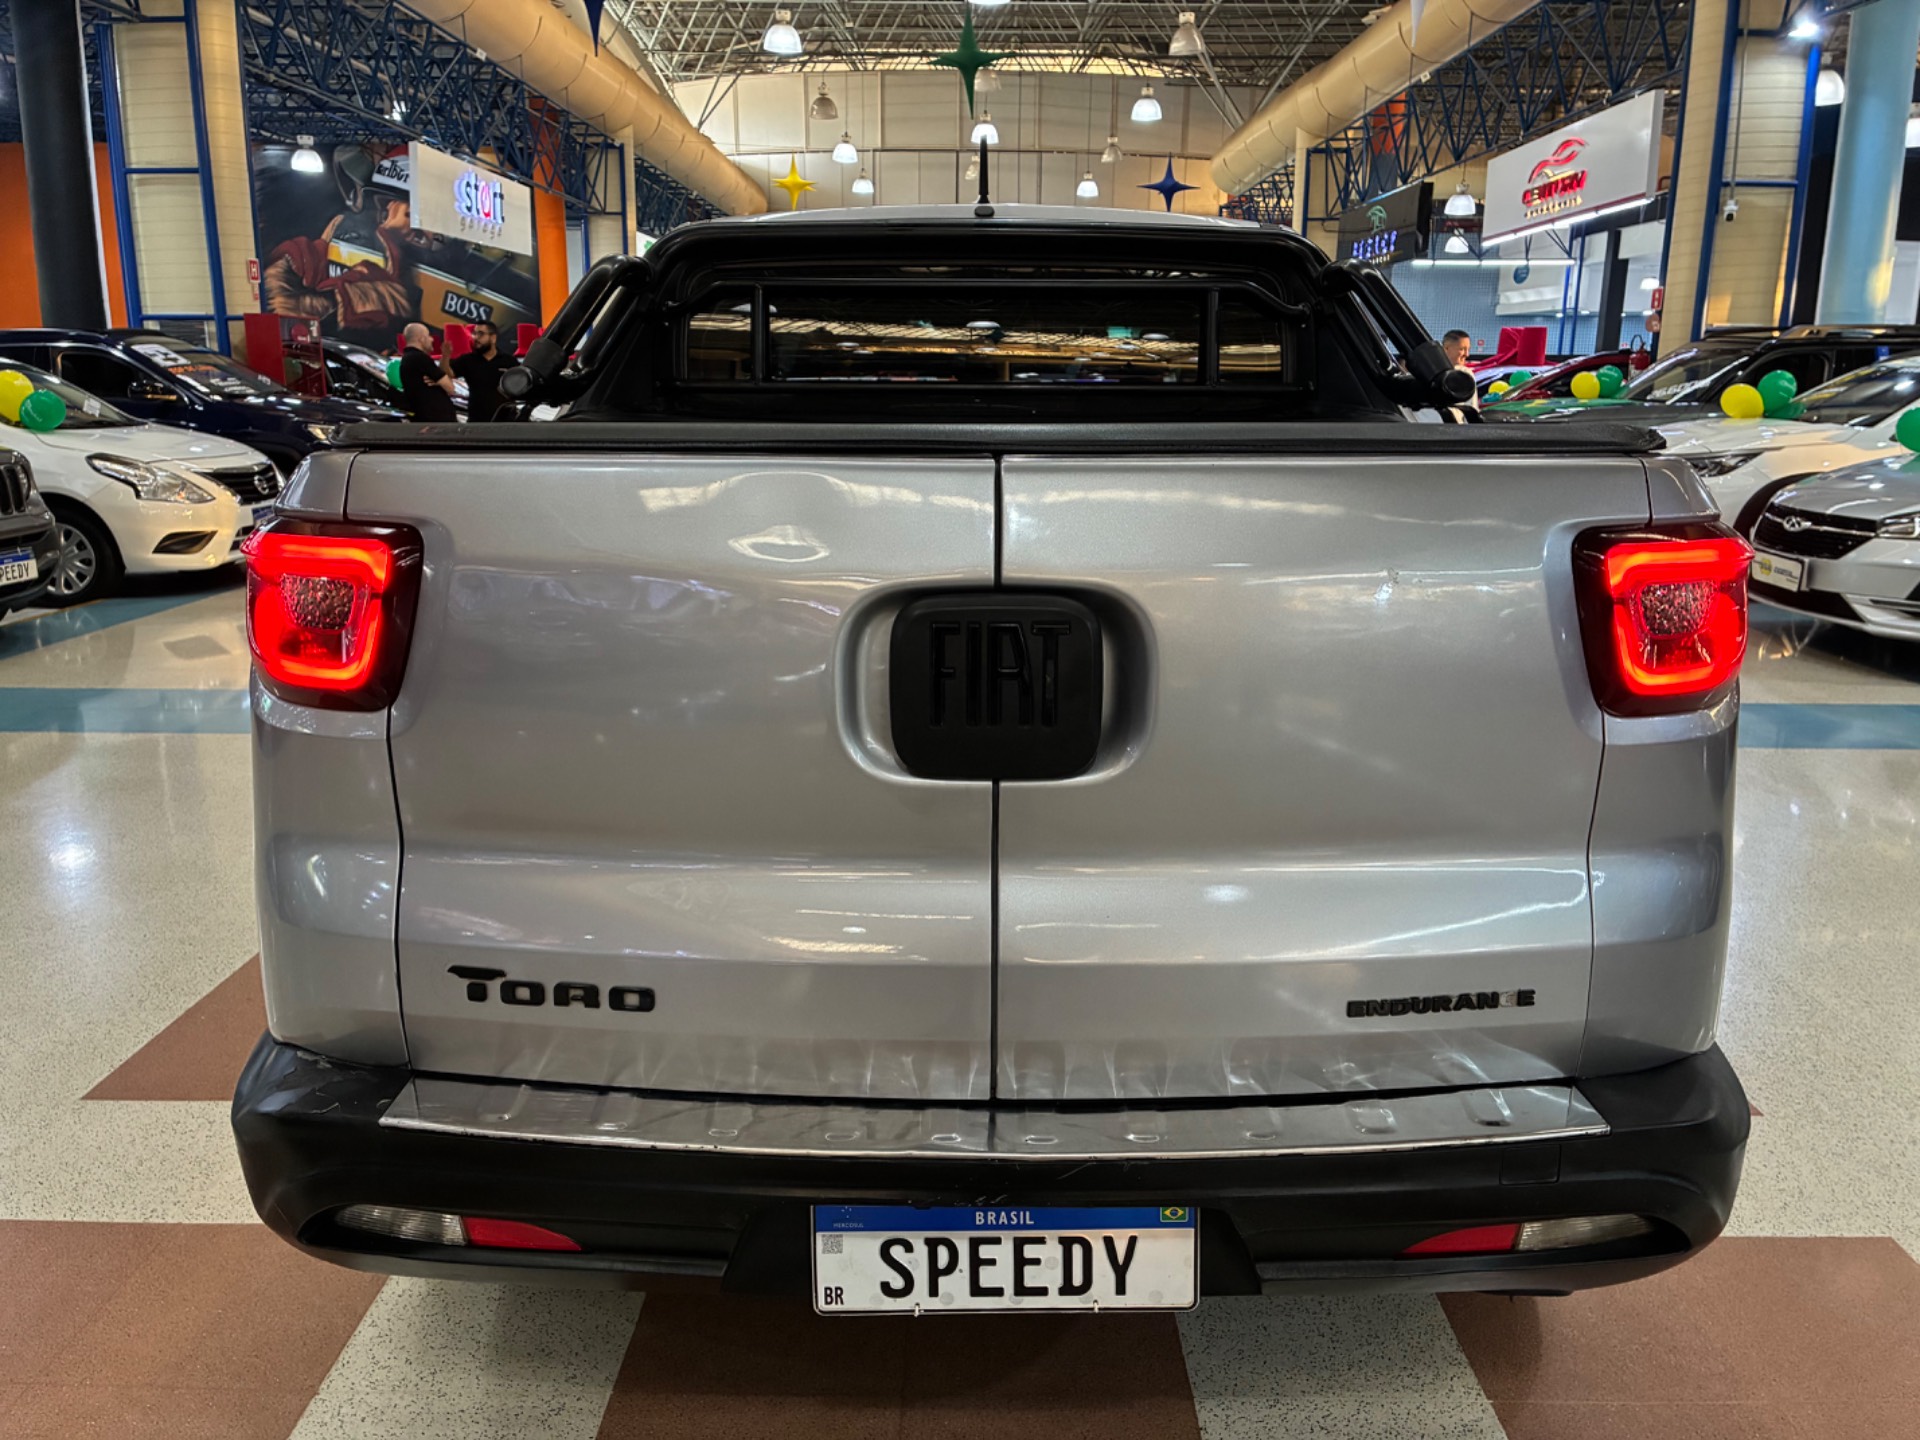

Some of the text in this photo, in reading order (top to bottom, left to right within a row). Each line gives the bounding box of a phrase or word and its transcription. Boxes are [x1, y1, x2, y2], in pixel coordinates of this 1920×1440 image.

[445, 292, 490, 321] BOSS
[930, 620, 1071, 728] FIAT
[447, 965, 656, 1012] TORO
[1346, 988, 1536, 1018] ENDURANCE
[975, 1211, 1035, 1226] BRASIL
[879, 1234, 1138, 1299] SPEEDY
[823, 1286, 845, 1305] BR
